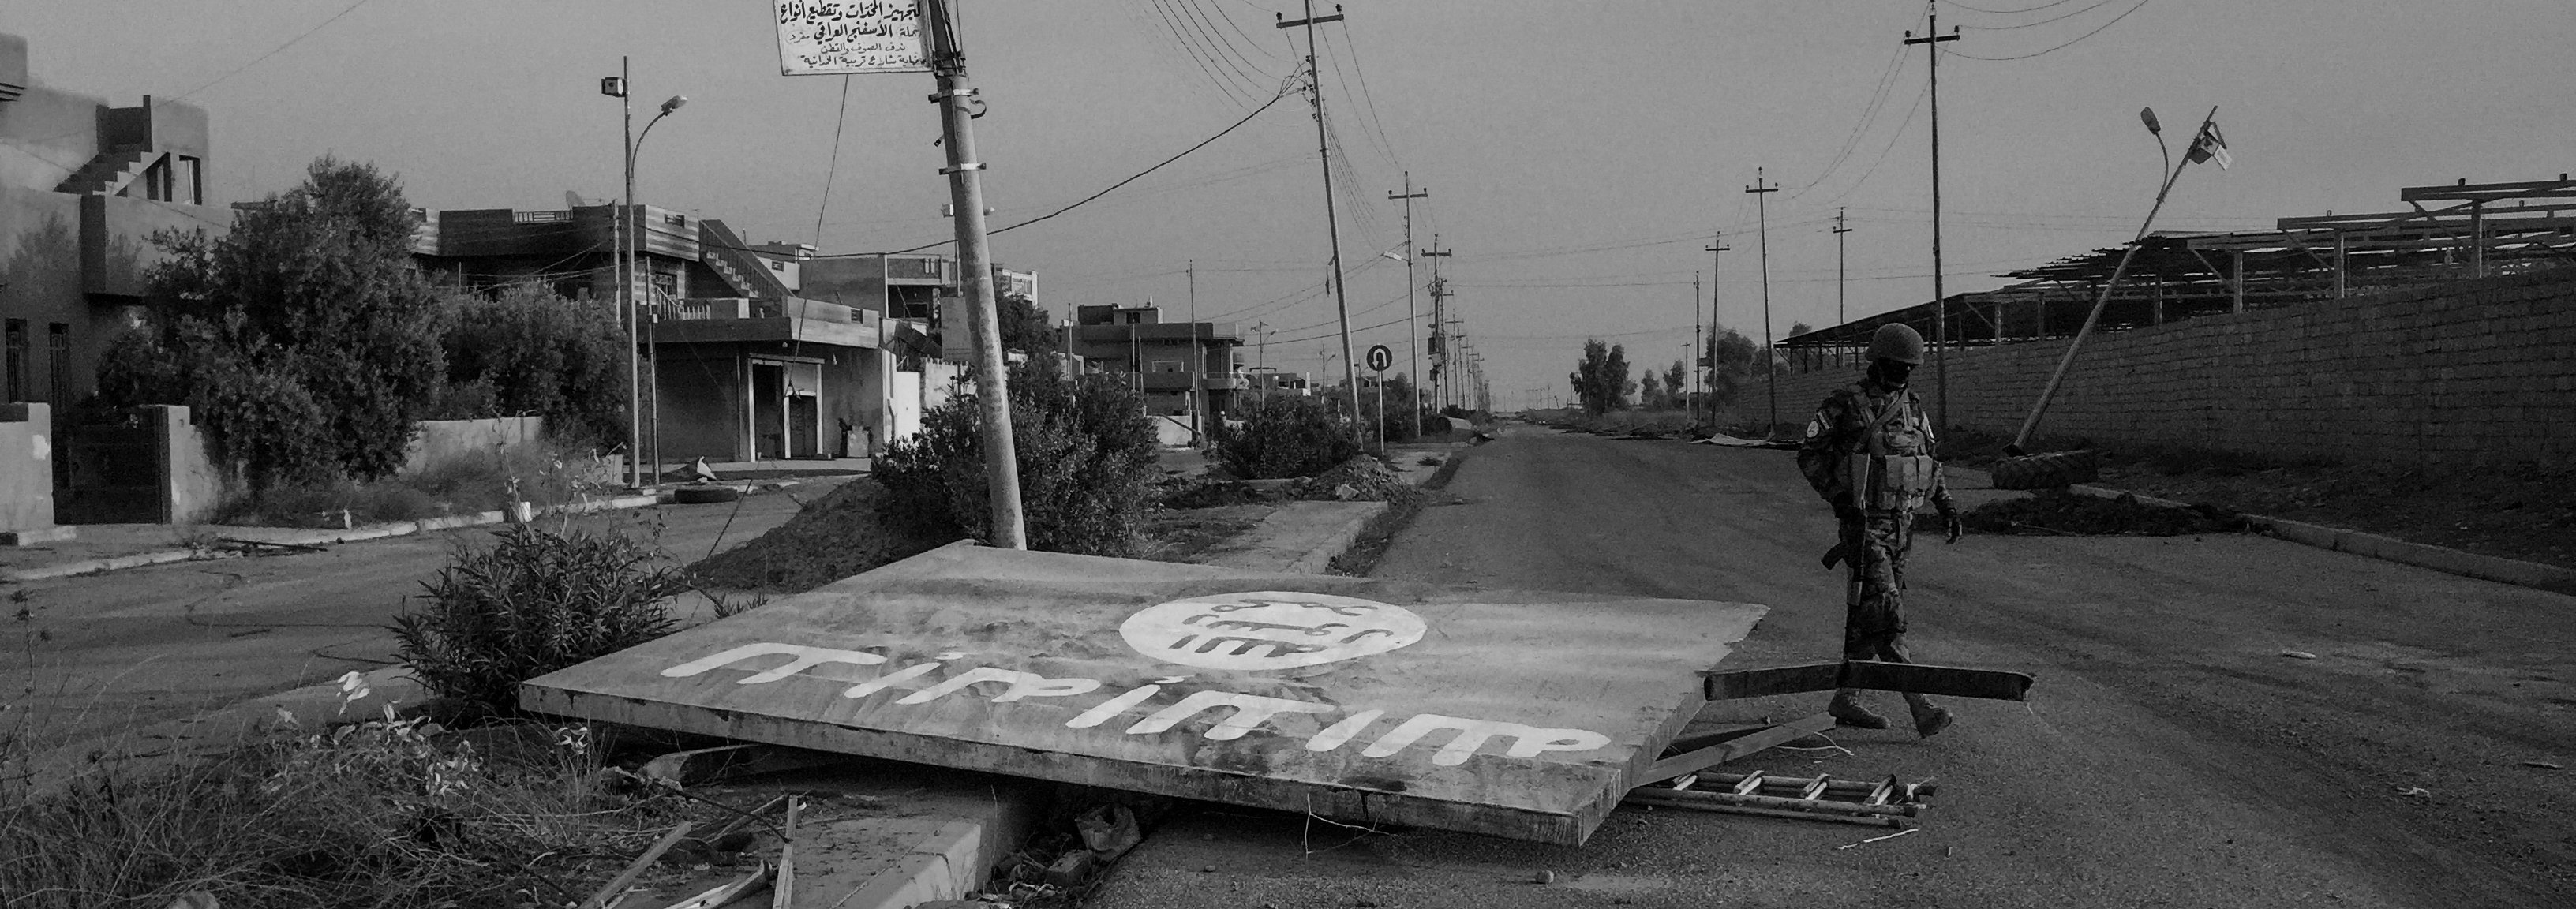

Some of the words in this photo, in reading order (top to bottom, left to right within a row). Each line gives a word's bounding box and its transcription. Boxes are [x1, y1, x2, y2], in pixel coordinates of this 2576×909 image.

[789, 32, 810, 43] مفرد
[814, 21, 848, 45] العراقي
[821, 43, 849, 55] والقطن
[851, 42, 882, 54] الصوف
[868, 55, 897, 66] شارع
[1211, 599, 1378, 616] محمد
[1181, 614, 1395, 644] رسول
[1168, 634, 1327, 657] الله
[661, 642, 887, 684] لا
[1307, 709, 1611, 766] الله
